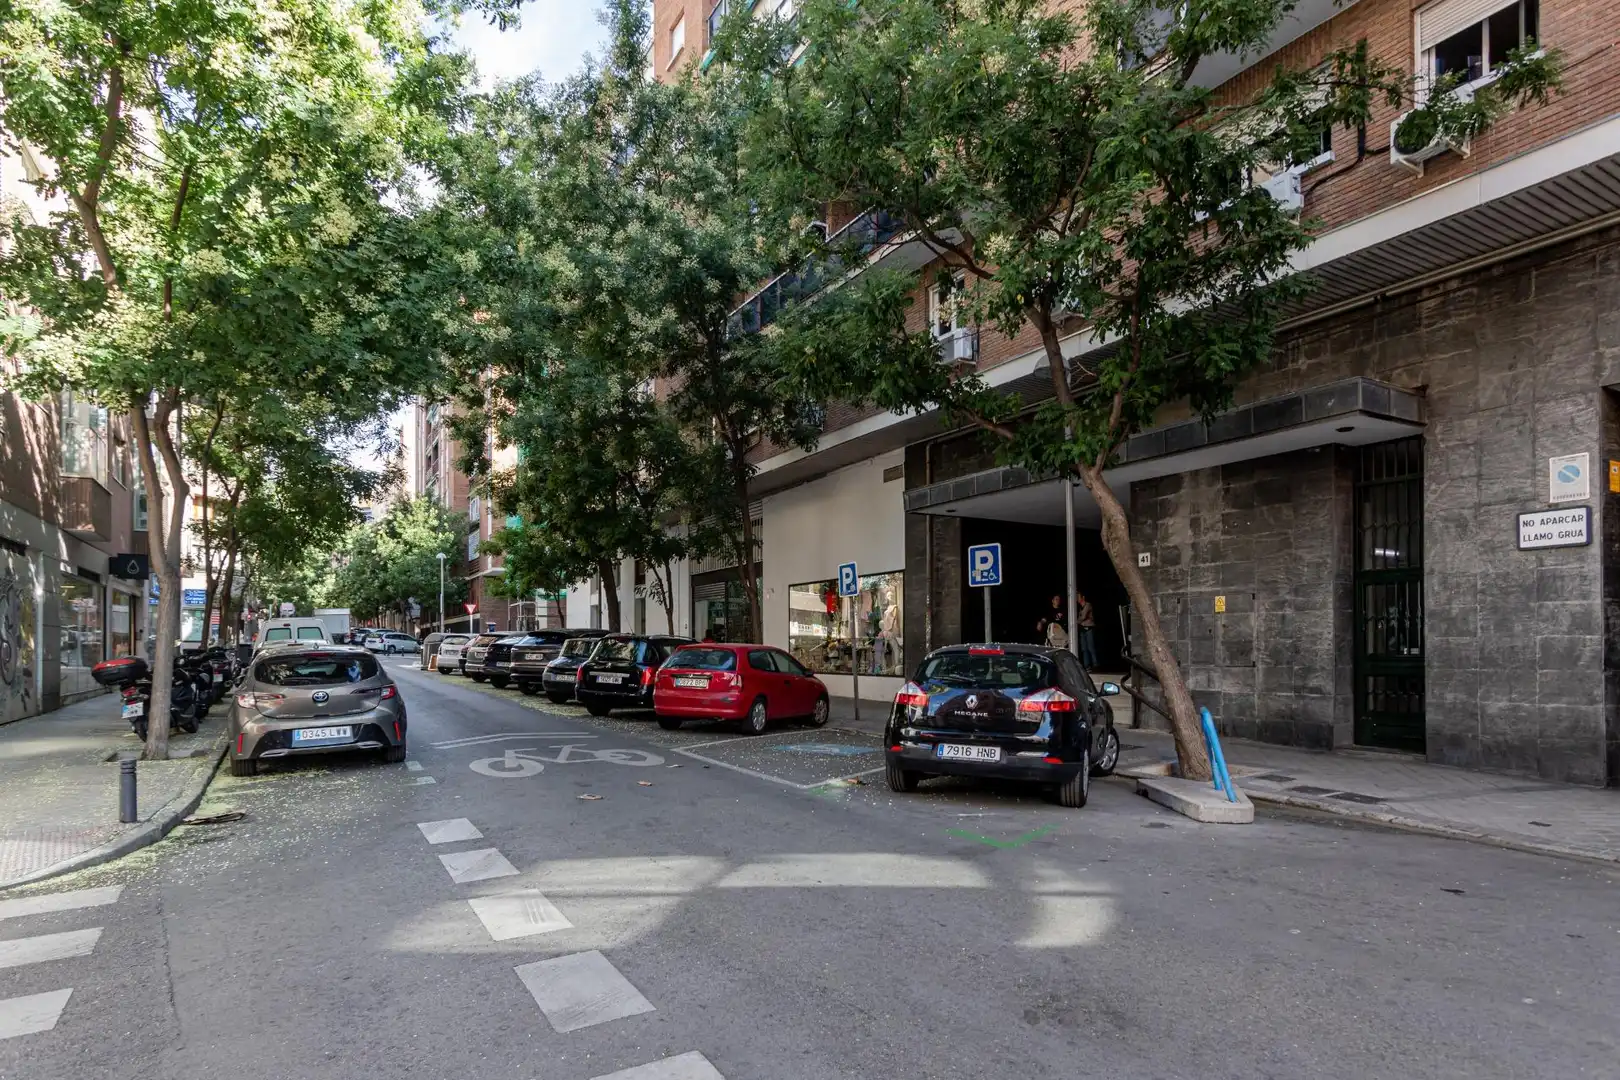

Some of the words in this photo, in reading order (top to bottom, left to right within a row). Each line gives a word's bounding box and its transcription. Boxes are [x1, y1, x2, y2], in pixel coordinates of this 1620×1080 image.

[1522, 519, 1535, 528] NO
[1540, 514, 1584, 526] APARCAR
[1523, 532, 1553, 542] LLAMO
[1558, 529, 1584, 539] GRUA
[974, 550, 994, 581] P
[1140, 555, 1149, 564] 41
[842, 567, 854, 594] P
[302, 729, 327, 739] 0345
[946, 745, 972, 756] 7916
[976, 747, 996, 758] HNB
